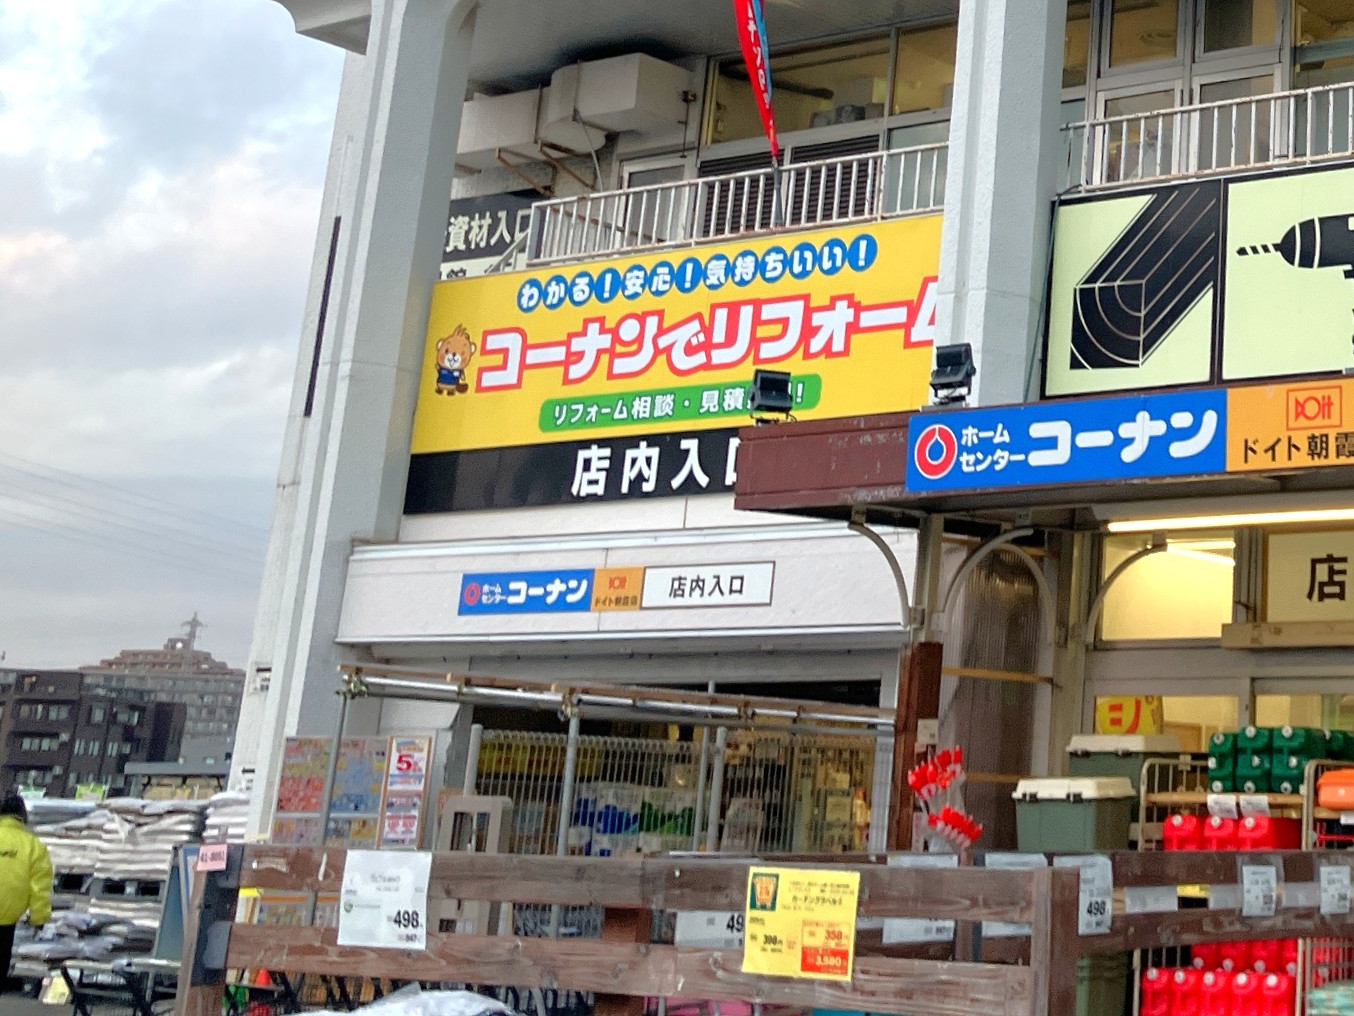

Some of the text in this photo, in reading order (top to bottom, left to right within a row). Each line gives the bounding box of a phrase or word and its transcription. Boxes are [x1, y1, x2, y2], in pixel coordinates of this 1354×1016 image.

[961, 422, 1010, 447] ホーム
[1027, 410, 1218, 466] コーナン
[959, 449, 1025, 472] センター
[507, 578, 588, 604] コーナン
[669, 575, 744, 598] 店内入口
[394, 909, 419, 929] 498
